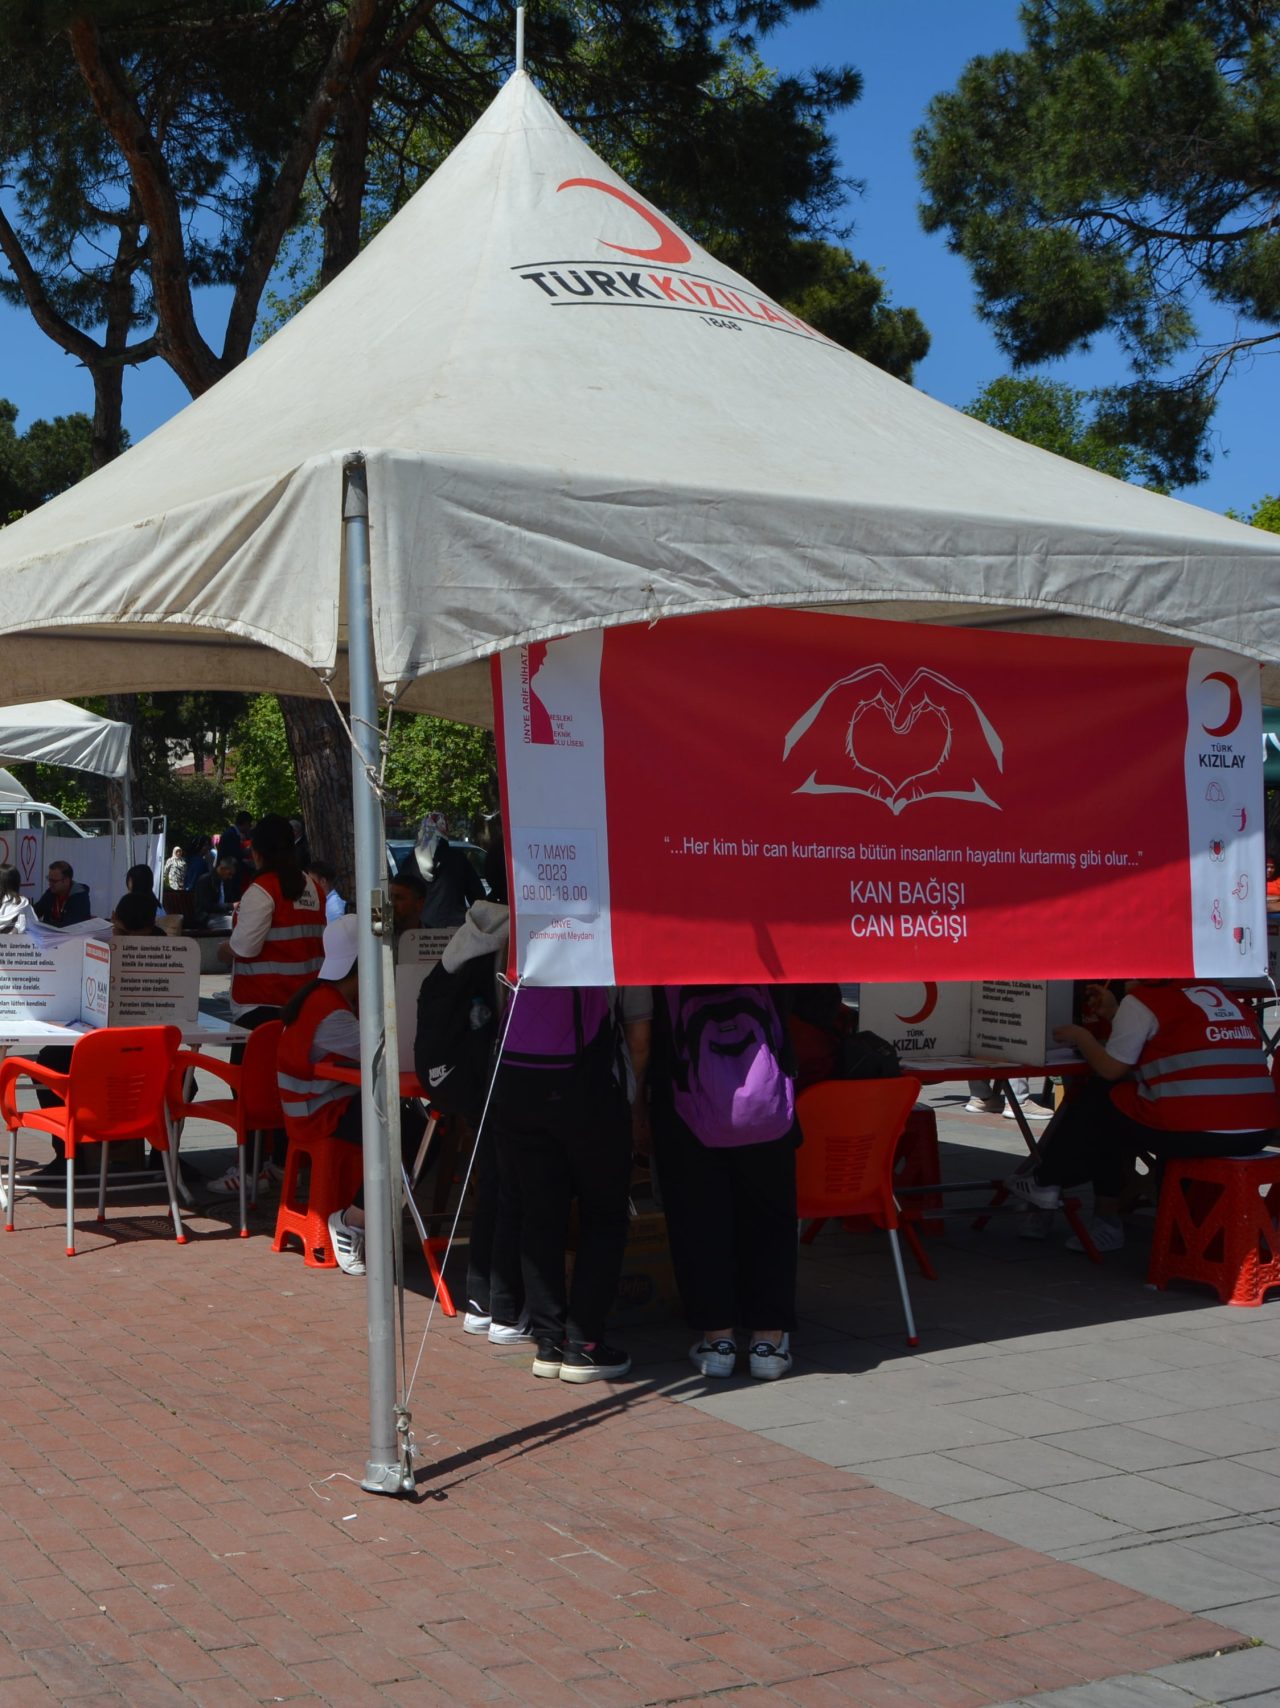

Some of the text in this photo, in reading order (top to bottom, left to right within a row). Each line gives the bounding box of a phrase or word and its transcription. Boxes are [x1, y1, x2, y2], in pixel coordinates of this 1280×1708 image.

[699, 316, 743, 332] 1868
[554, 730, 571, 738] EKNİK
[1211, 743, 1232, 752] TÜRK
[1199, 754, 1246, 768] KIZILAY
[528, 844, 576, 860] 17 MAYIS
[713, 838, 738, 856] kim
[742, 839, 760, 857] bir
[763, 842, 788, 858] can
[792, 841, 856, 860] kurtarırsa
[860, 844, 896, 861] bütün
[900, 845, 962, 862] insanların
[966, 847, 1016, 866] hayatını
[1020, 848, 1076, 869] kurtarmış
[1080, 850, 1101, 869] gibi
[538, 864, 568, 880] 2023
[522, 885, 588, 900] 09.00-18.00
[850, 878, 965, 910] KAN BAĞIŞI
[551, 918, 572, 928] ÜNYE
[851, 910, 967, 943] CAN BAĞIŞI
[906, 1028, 924, 1037] TÜRK
[893, 1037, 937, 1052] KIZILAY
